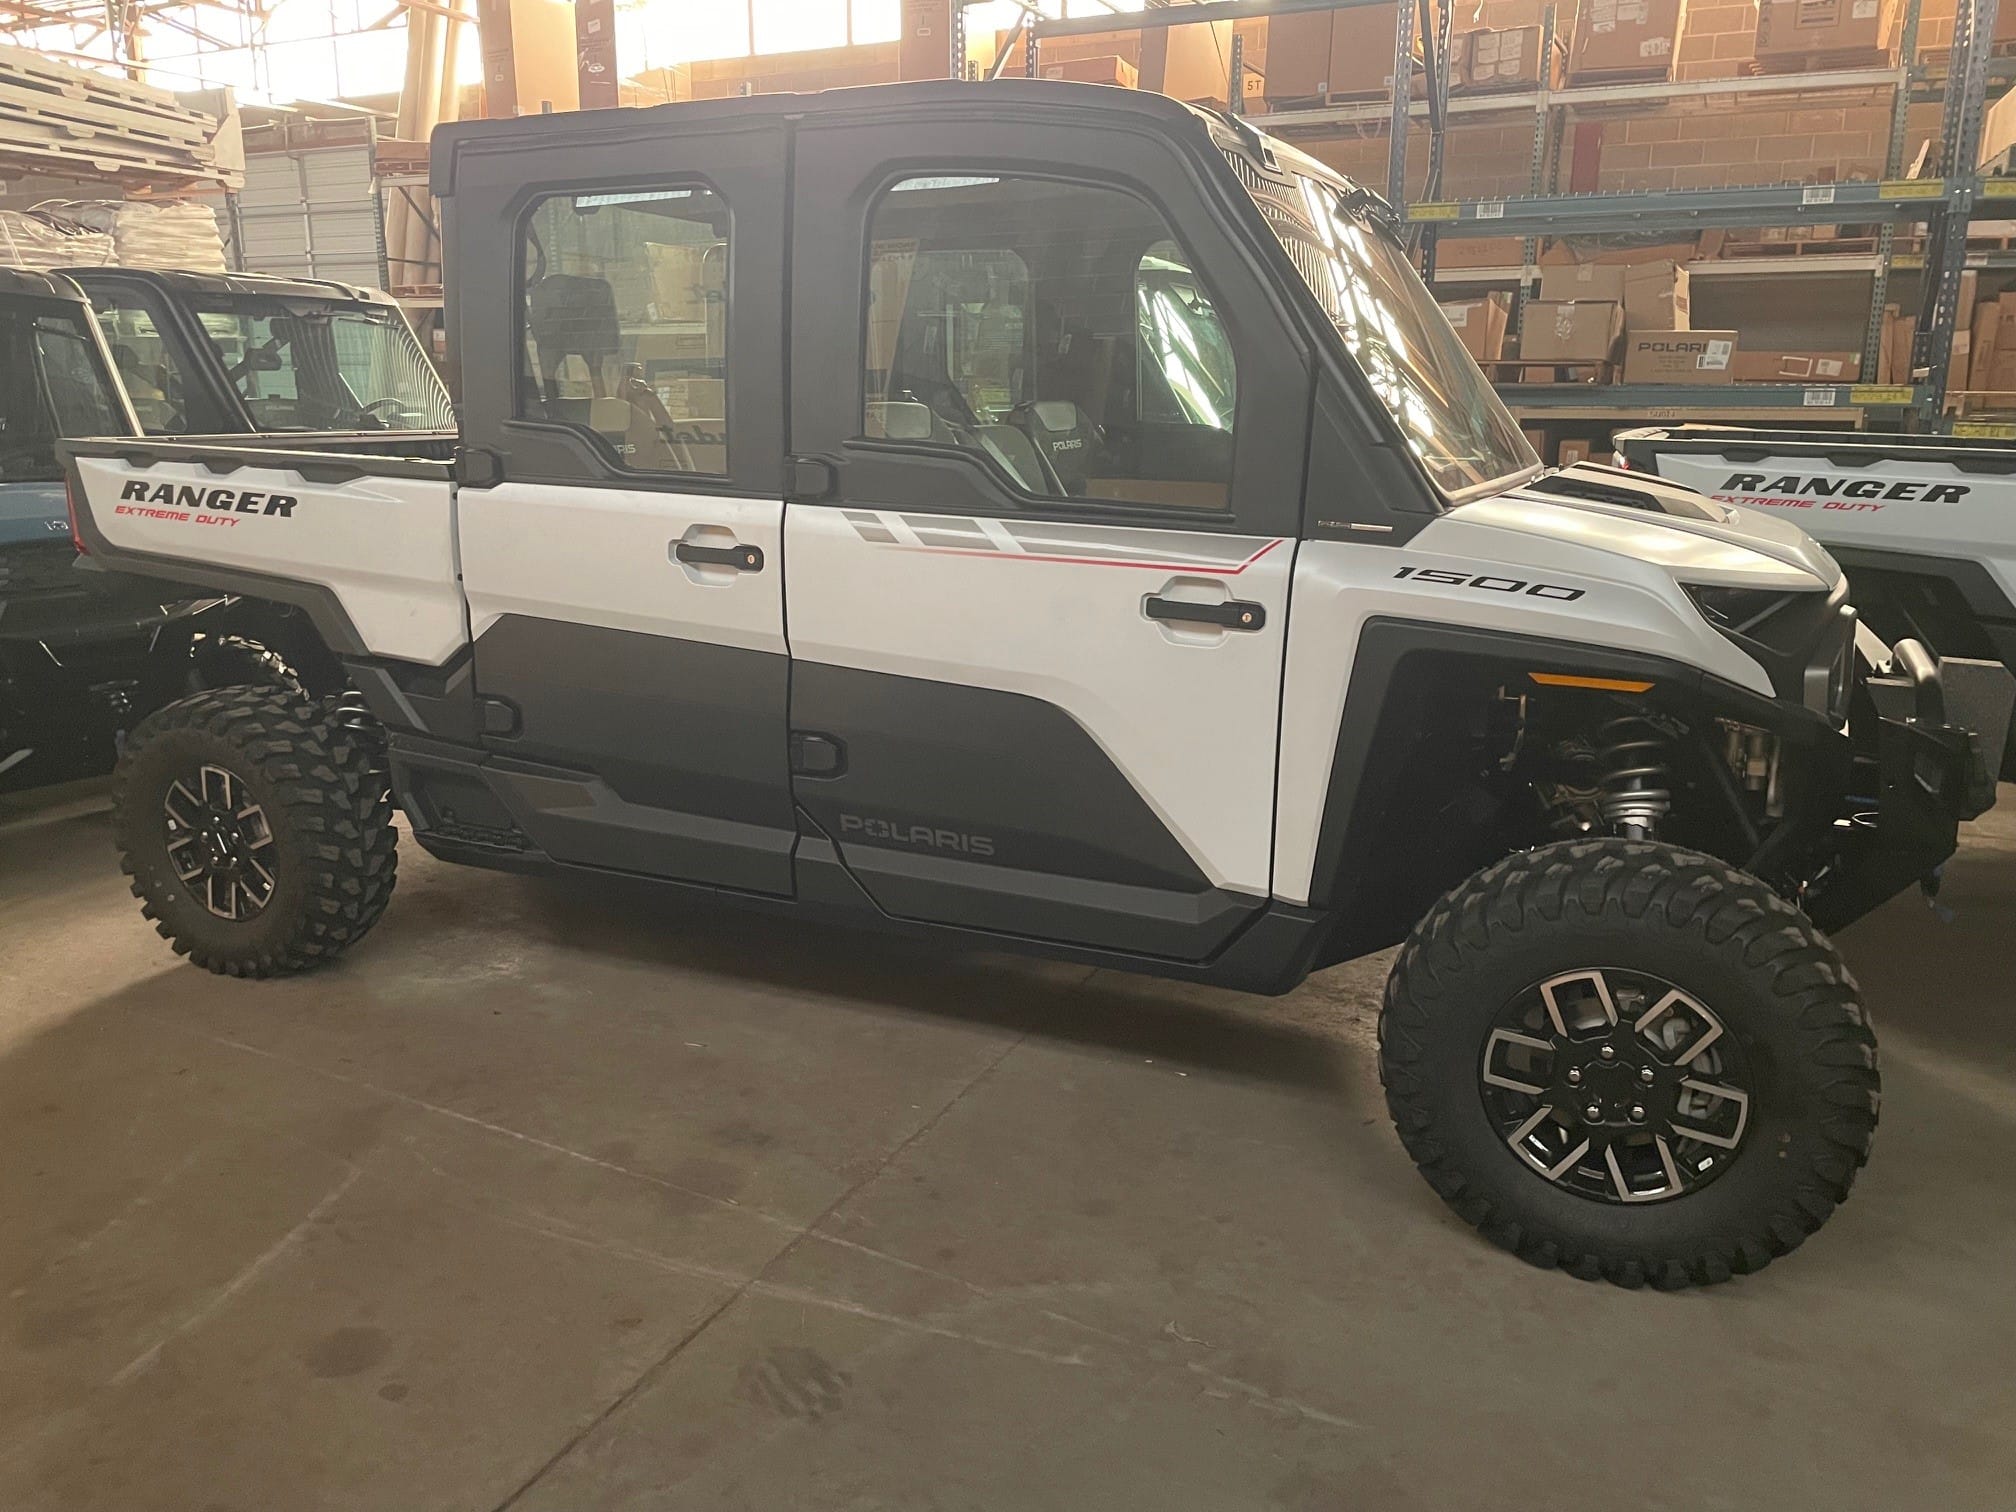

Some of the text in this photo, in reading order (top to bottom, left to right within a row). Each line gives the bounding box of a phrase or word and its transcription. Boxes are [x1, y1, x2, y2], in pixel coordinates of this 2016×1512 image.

[1637, 342, 1708, 353] POLARI
[1052, 439, 1082, 451] POLARIS
[120, 480, 298, 518] RANGER
[1719, 473, 1971, 504] RANGER
[114, 505, 241, 527] EXTREME DUTY
[1710, 495, 1886, 513] EXTREME DUTY
[1392, 566, 1586, 601] 1500
[839, 813, 995, 857] POLARIS
